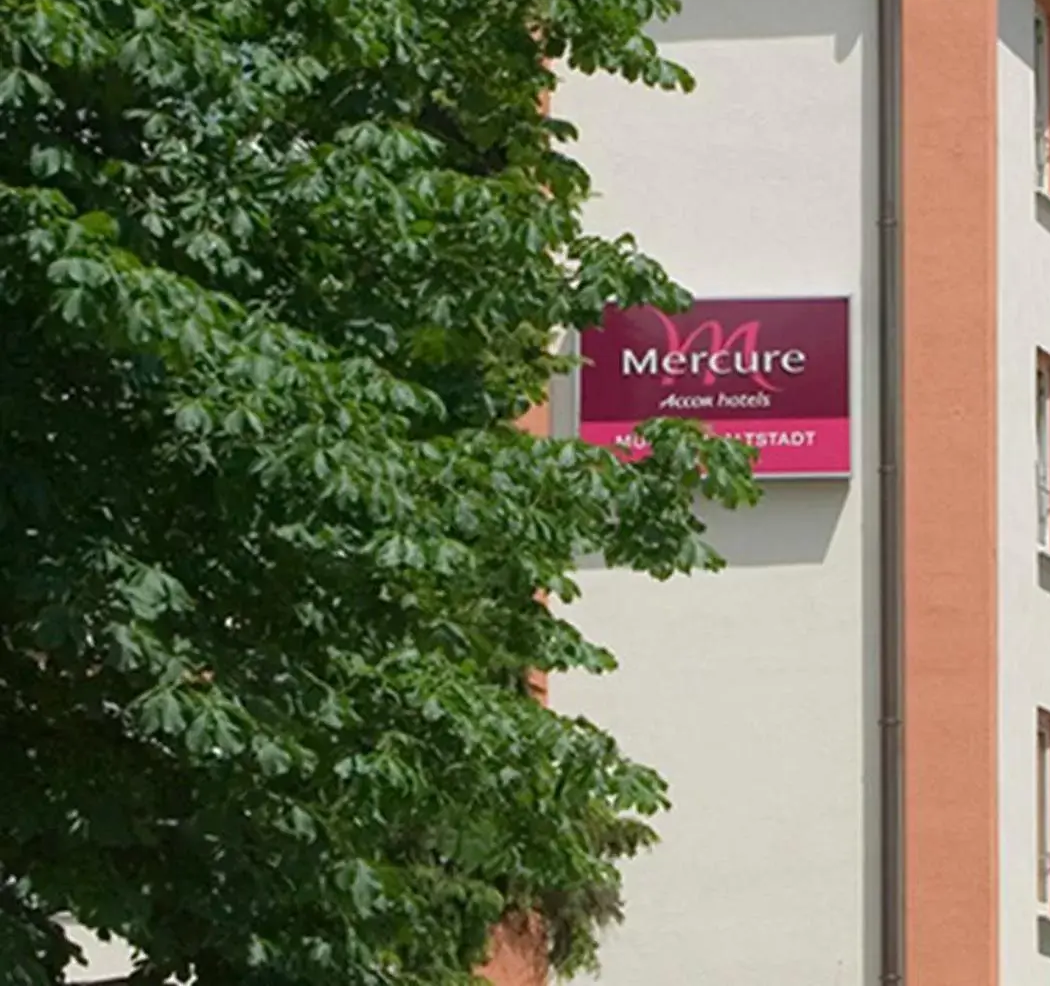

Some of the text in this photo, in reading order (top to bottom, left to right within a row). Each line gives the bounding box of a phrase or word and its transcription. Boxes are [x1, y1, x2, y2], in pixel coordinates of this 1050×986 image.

[622, 347, 806, 375] Mercure
[717, 391, 771, 408] hotels
[725, 430, 816, 447] TSTADT
